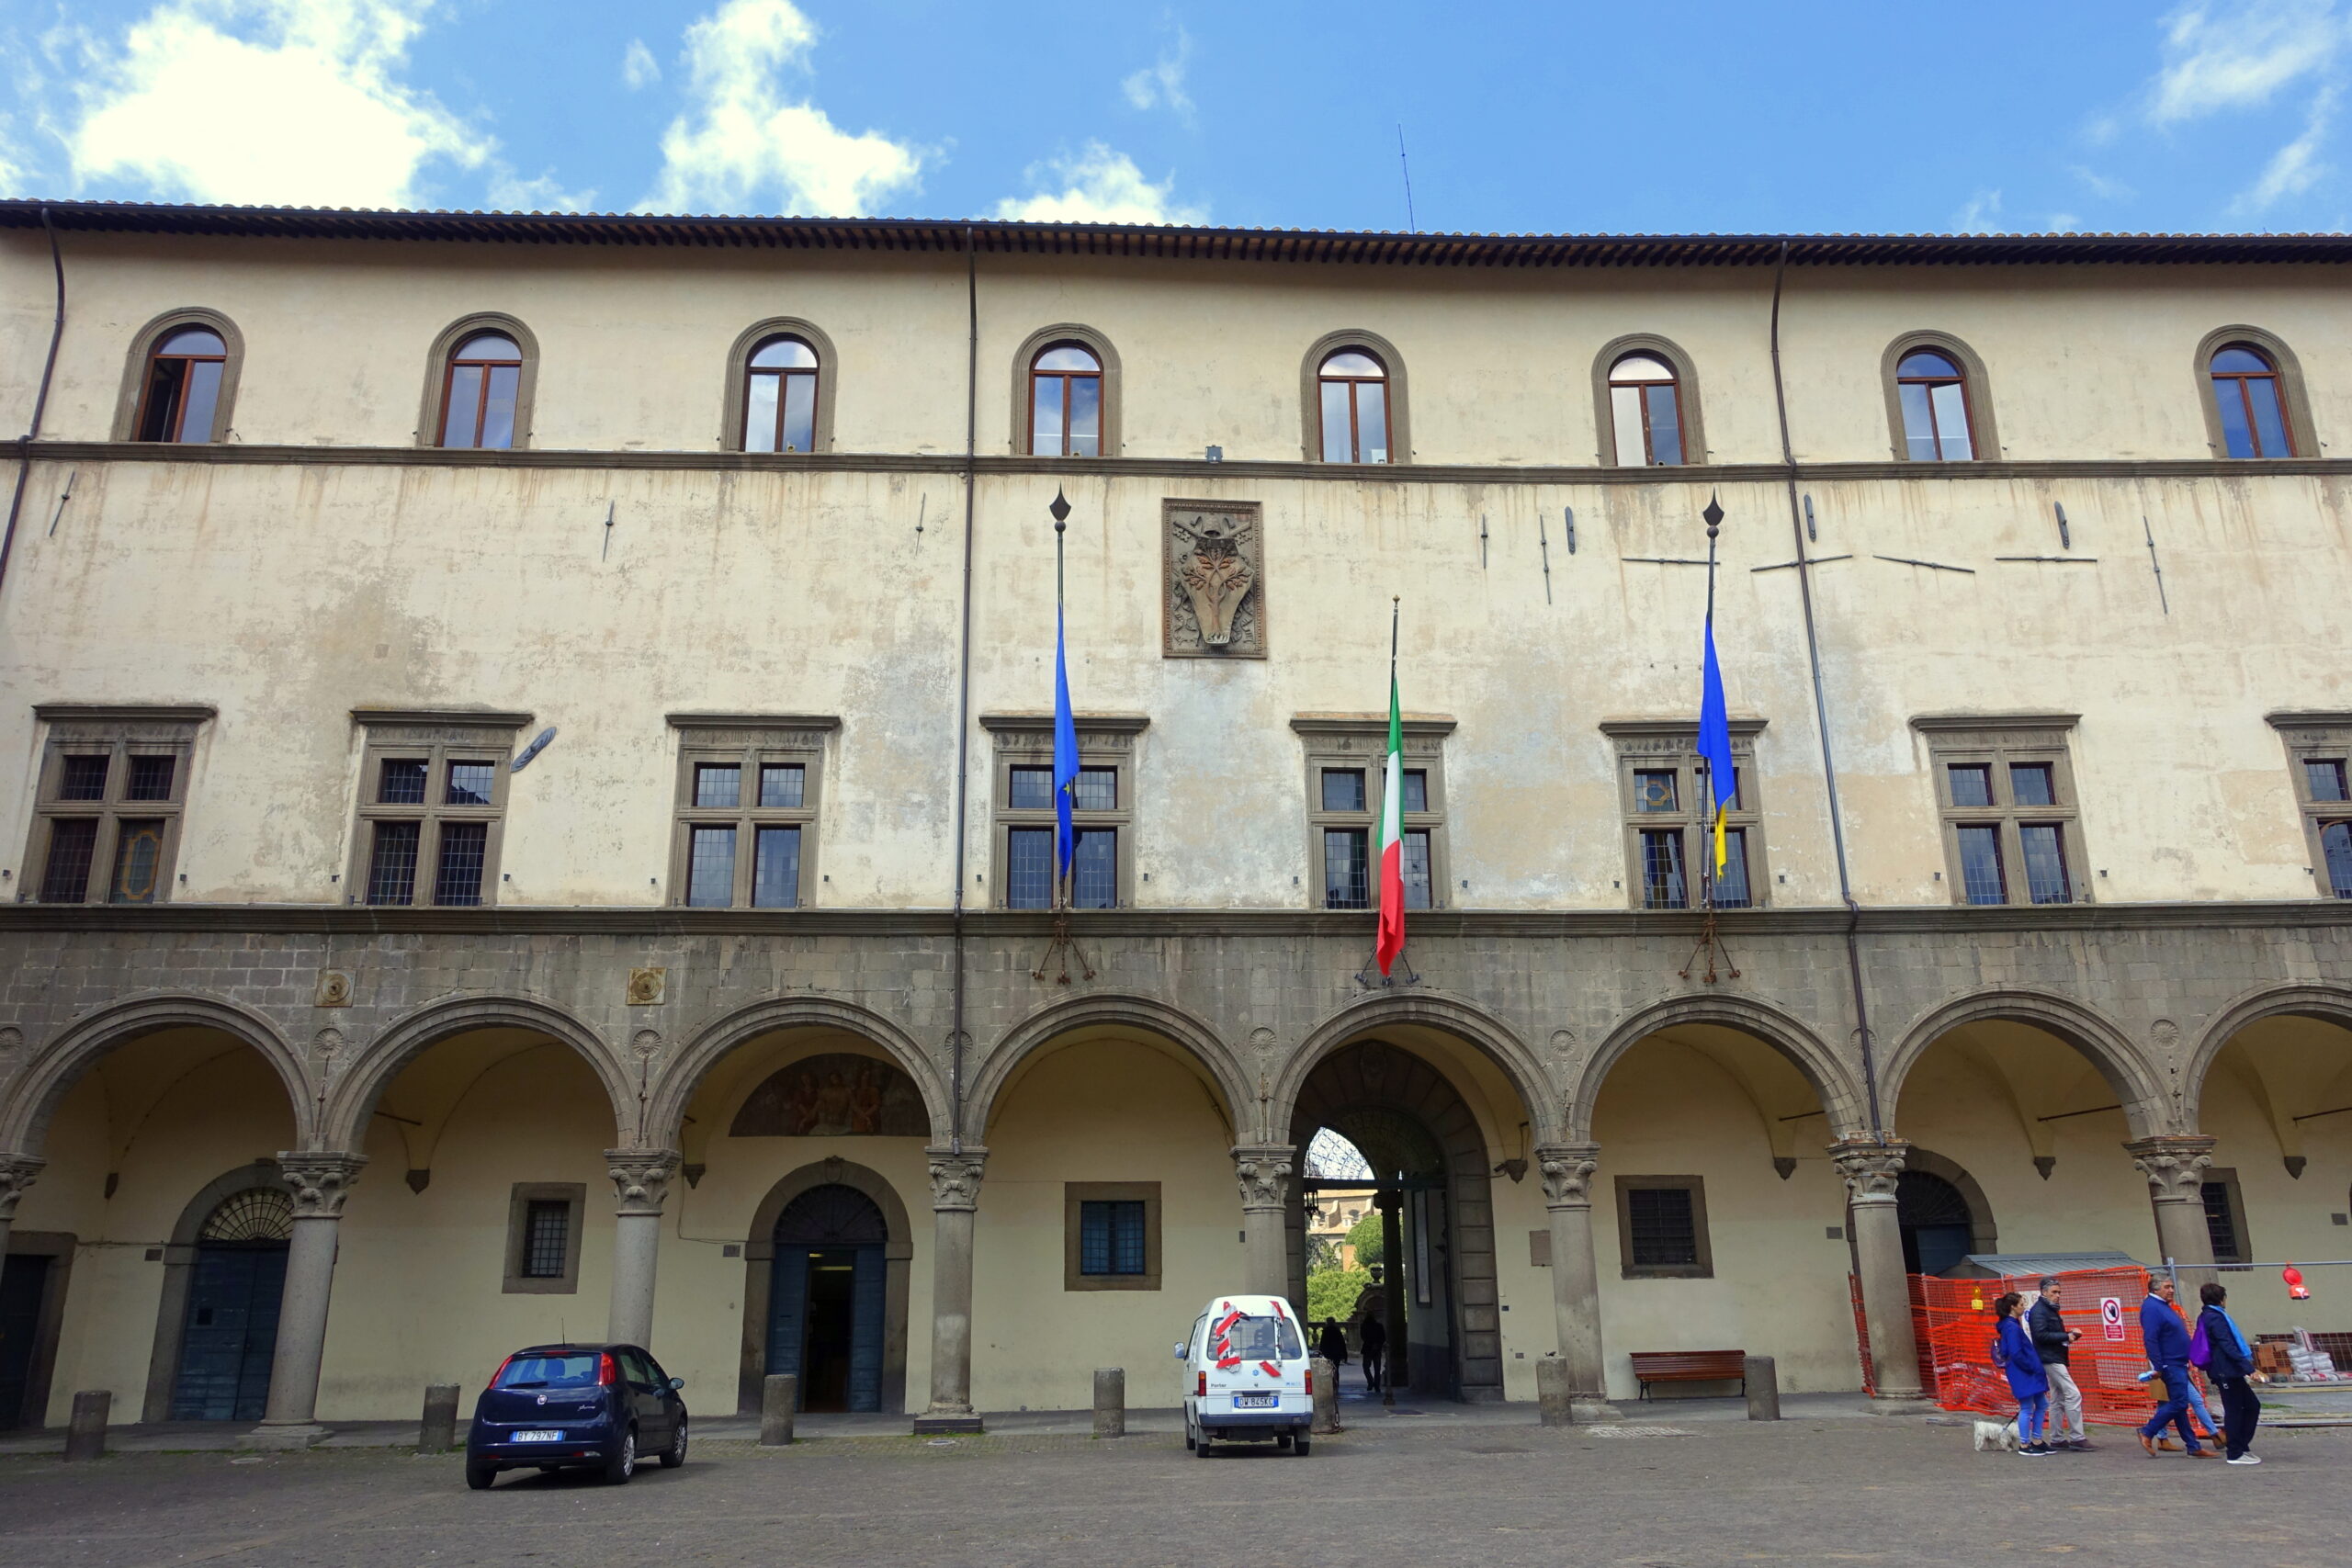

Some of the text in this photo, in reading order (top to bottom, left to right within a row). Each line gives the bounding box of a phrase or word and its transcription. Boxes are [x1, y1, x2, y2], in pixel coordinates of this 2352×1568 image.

[1250, 1397, 1273, 1406] 845KC
[517, 1430, 558, 1441] BY 797NF
